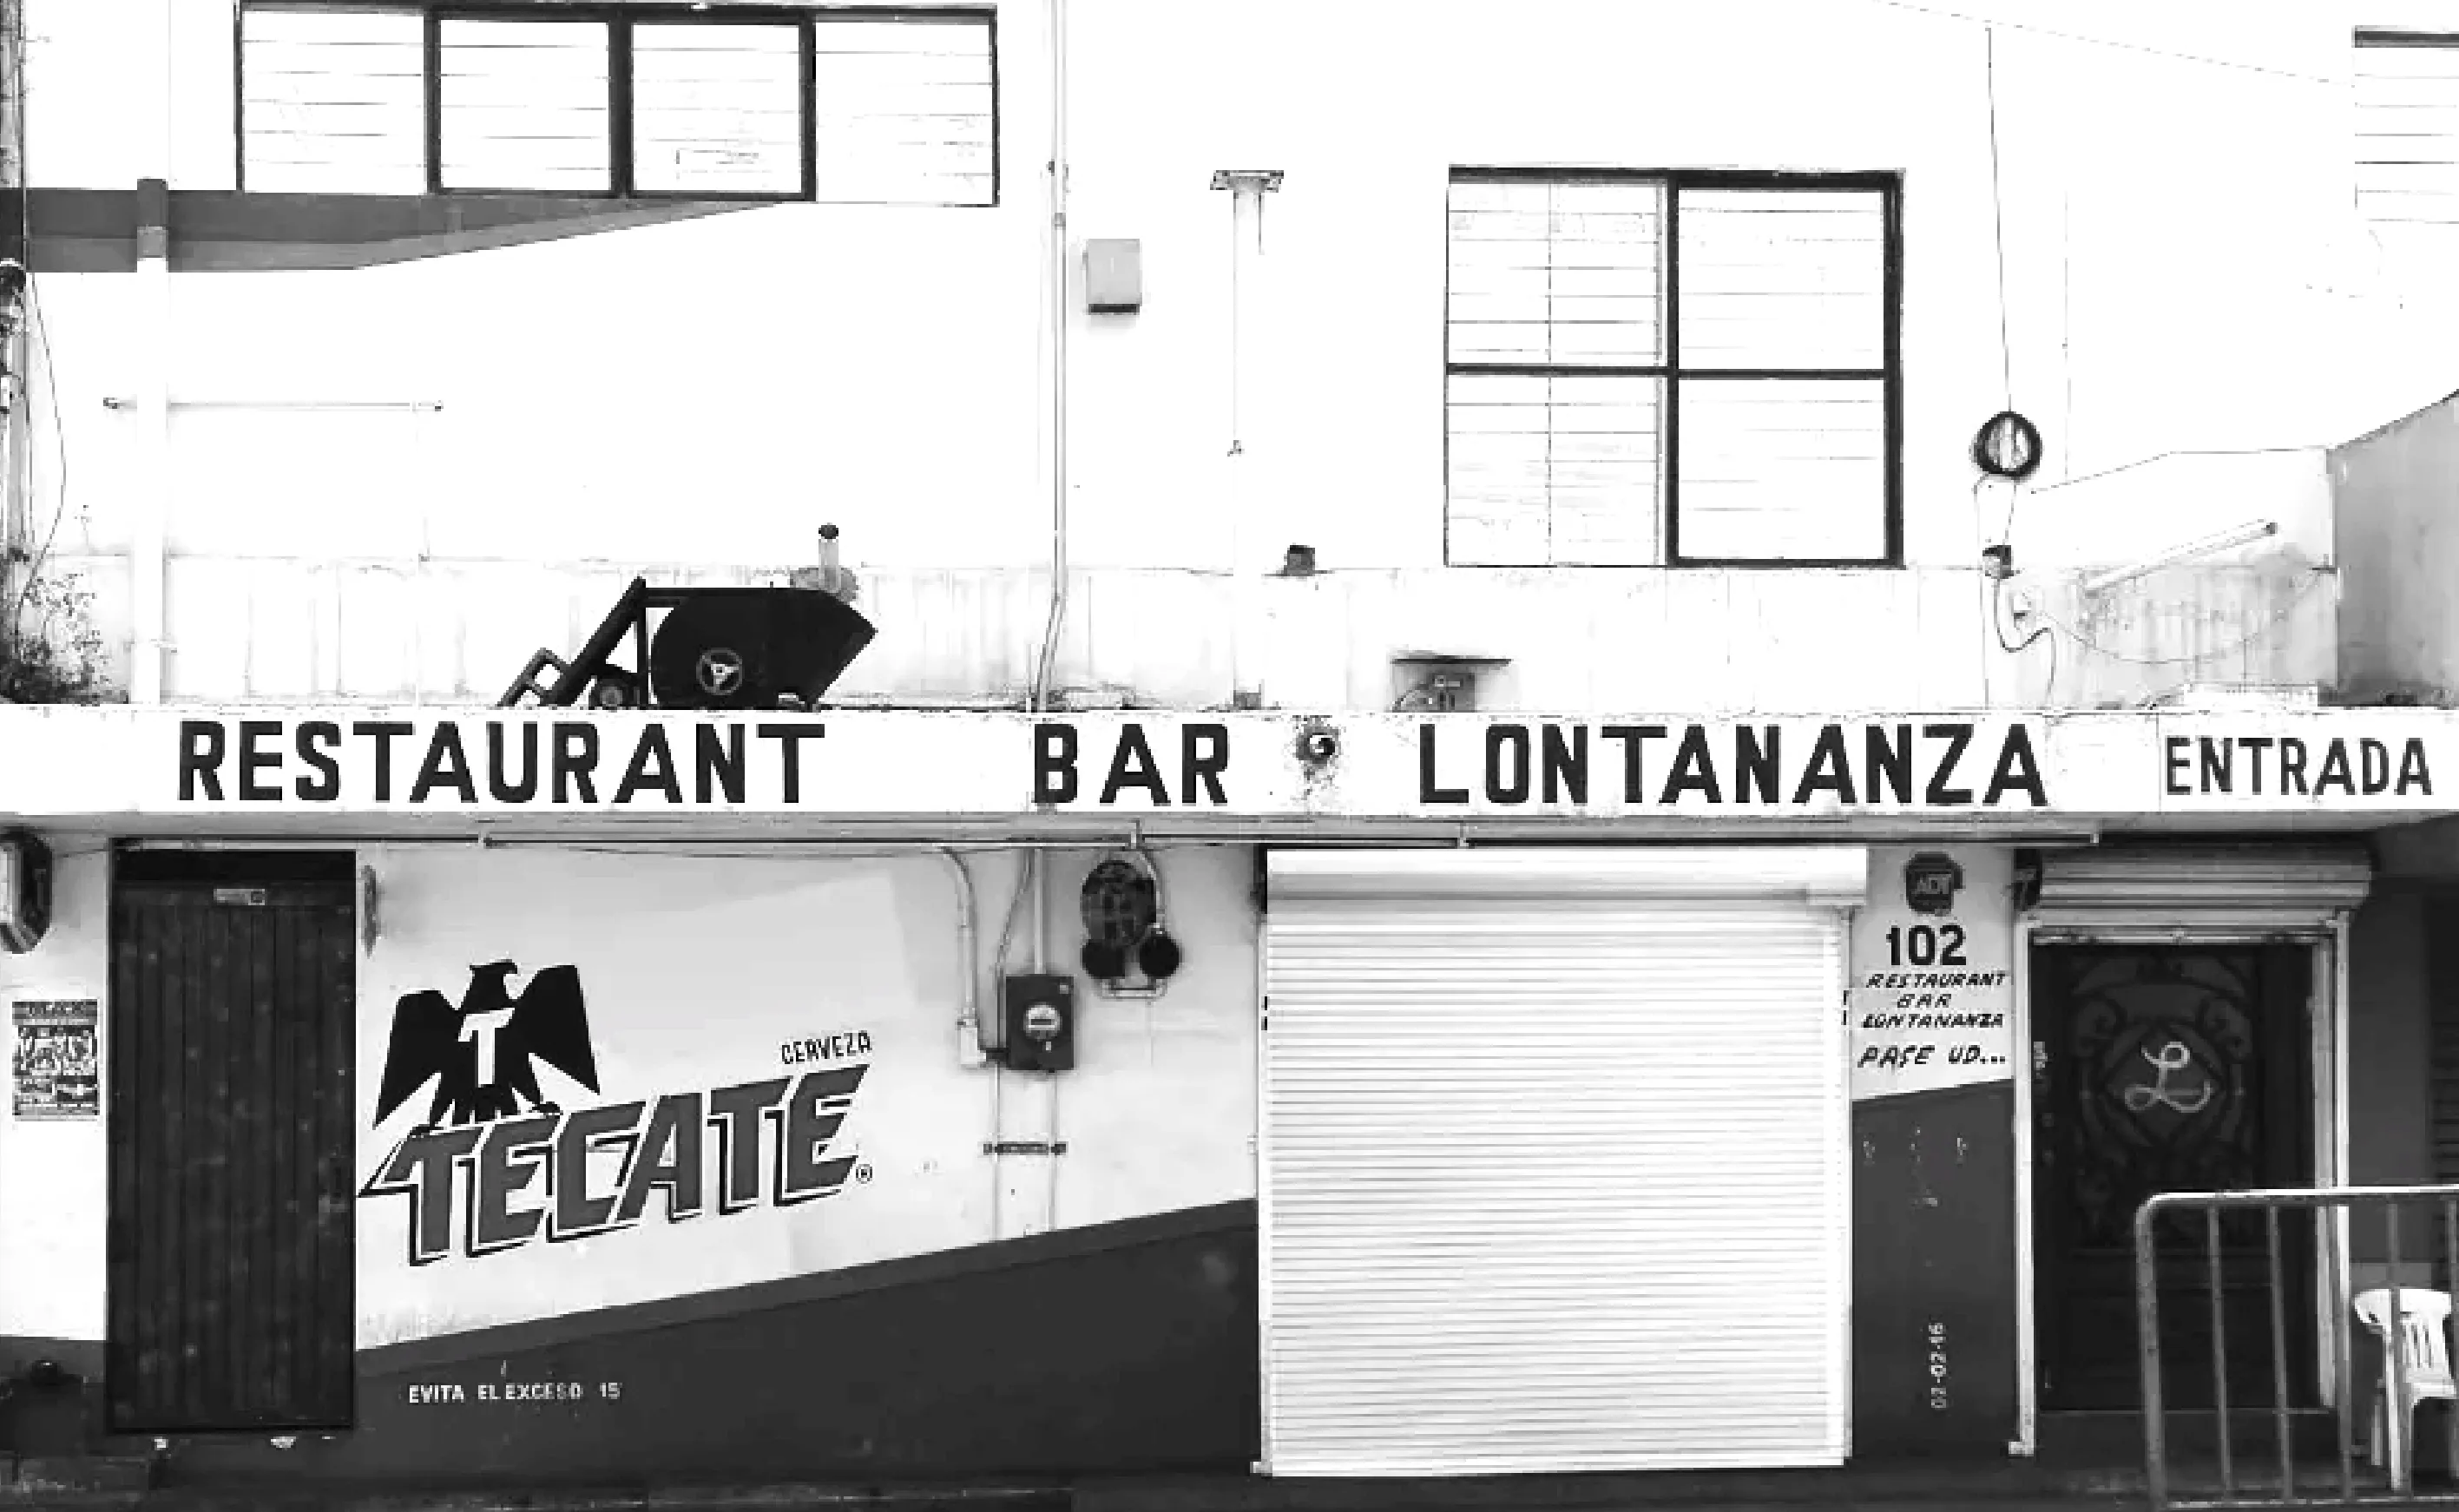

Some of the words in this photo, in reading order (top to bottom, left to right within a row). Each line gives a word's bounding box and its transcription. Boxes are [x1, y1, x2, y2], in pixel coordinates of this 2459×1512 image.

[177, 720, 825, 803] RESTAURANT
[1034, 723, 1229, 805] BAR
[1418, 722, 2048, 805] LONTANANZA
[2163, 736, 2434, 796] ENTRADA
[1911, 873, 1952, 895] ADT
[1886, 924, 1967, 965] 102
[1865, 972, 2008, 988] RESTAURANT
[1897, 993, 1952, 1009] BAR
[1862, 1013, 2004, 1029] LONTANANZA
[780, 1029, 872, 1065] CERVEZA
[1857, 1044, 1936, 1068] PASE
[357, 1064, 871, 1266] TECATE
[409, 1383, 465, 1403] EVITA
[477, 1383, 502, 1400] EL
[505, 1382, 583, 1401] EXCESO
